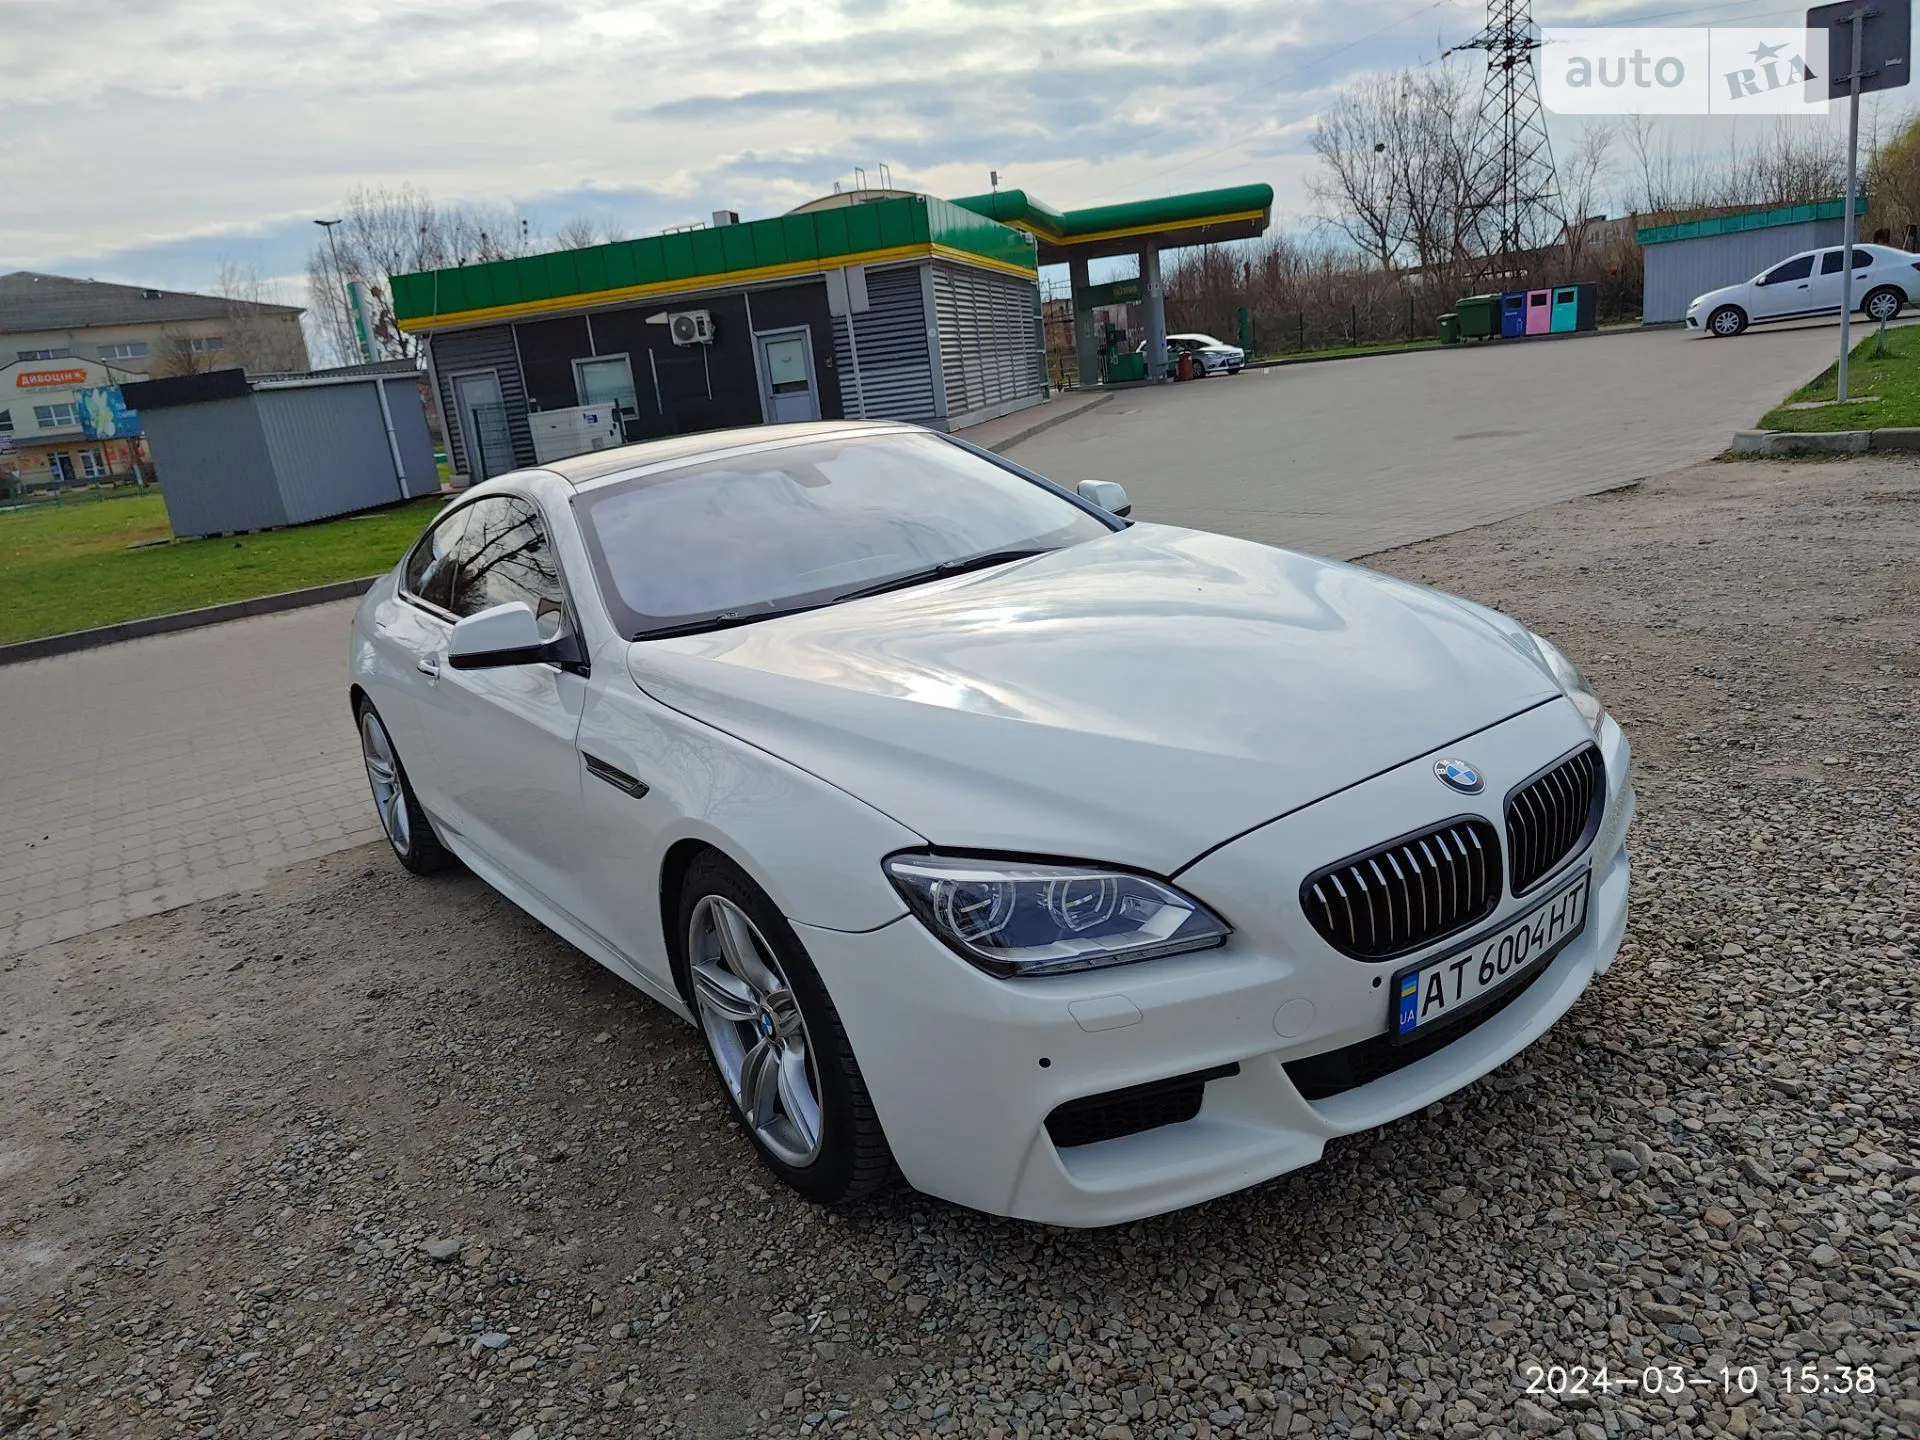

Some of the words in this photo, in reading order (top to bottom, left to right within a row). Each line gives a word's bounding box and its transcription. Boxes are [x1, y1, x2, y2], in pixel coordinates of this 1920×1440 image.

[1421, 954, 1473, 1017] AT
[1478, 911, 1546, 986] 6004
[1547, 881, 1585, 943] HT
[1400, 1010, 1416, 1025] UA
